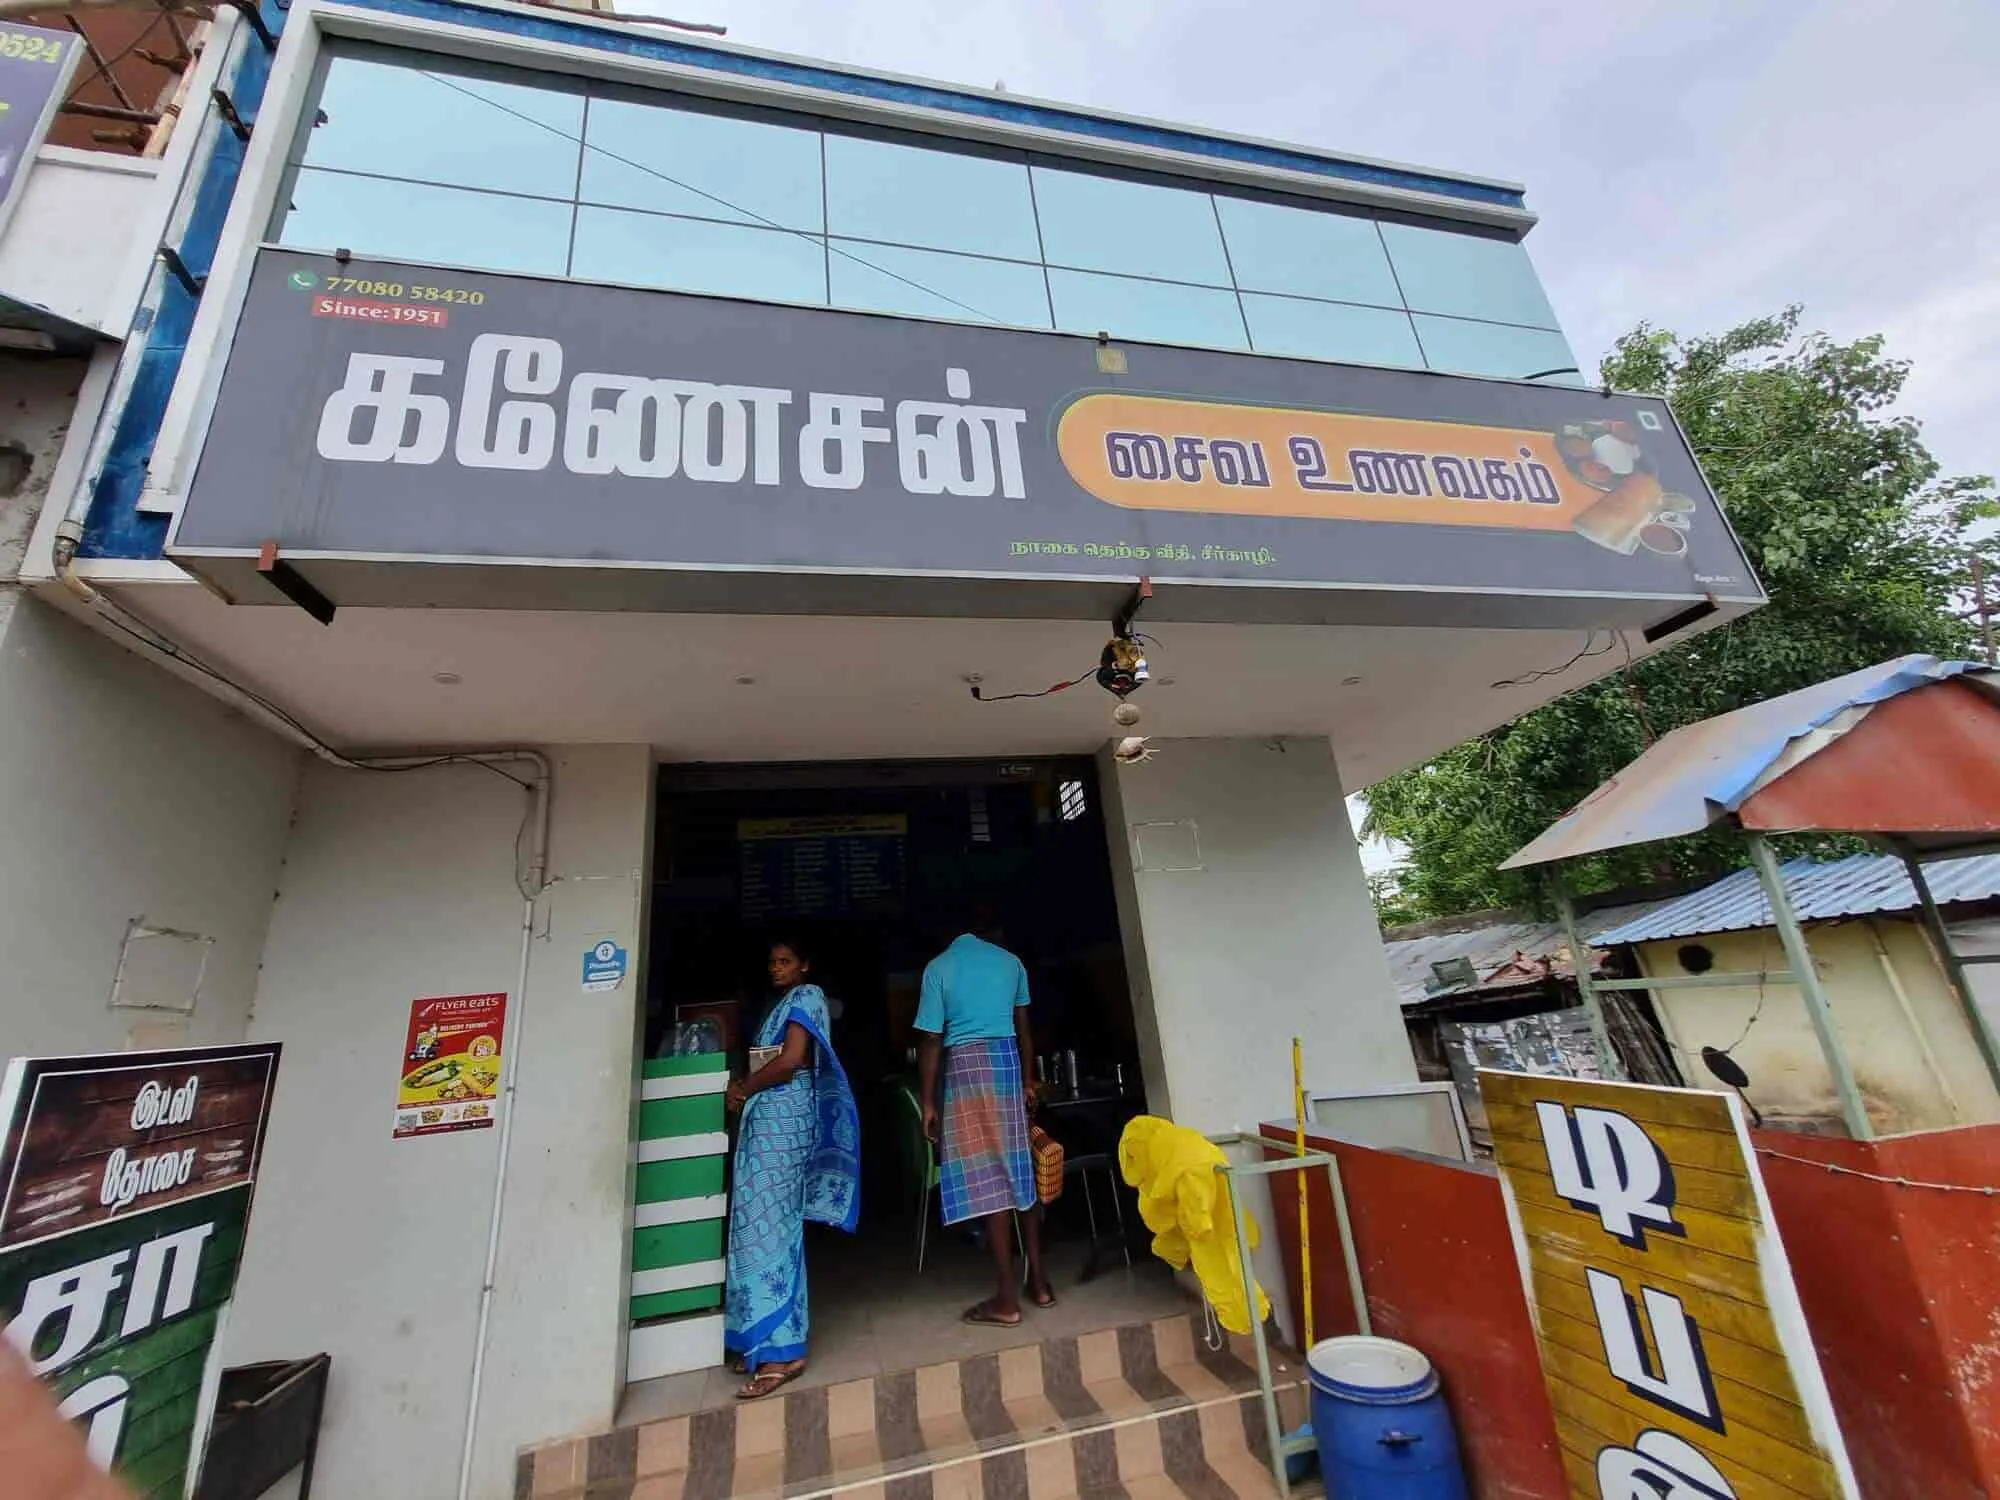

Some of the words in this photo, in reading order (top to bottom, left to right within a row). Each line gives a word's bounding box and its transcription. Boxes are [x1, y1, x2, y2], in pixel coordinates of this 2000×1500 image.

[326, 276, 403, 297] 77080
[409, 285, 485, 306] 58420
[319, 299, 442, 325] Since:1951
[316, 333, 1027, 499] கணேசன்
[1105, 431, 1272, 488] சைவ
[1287, 435, 1562, 504] உணவகம்
[435, 999, 467, 1011] FLYER
[468, 997, 499, 1009] eats
